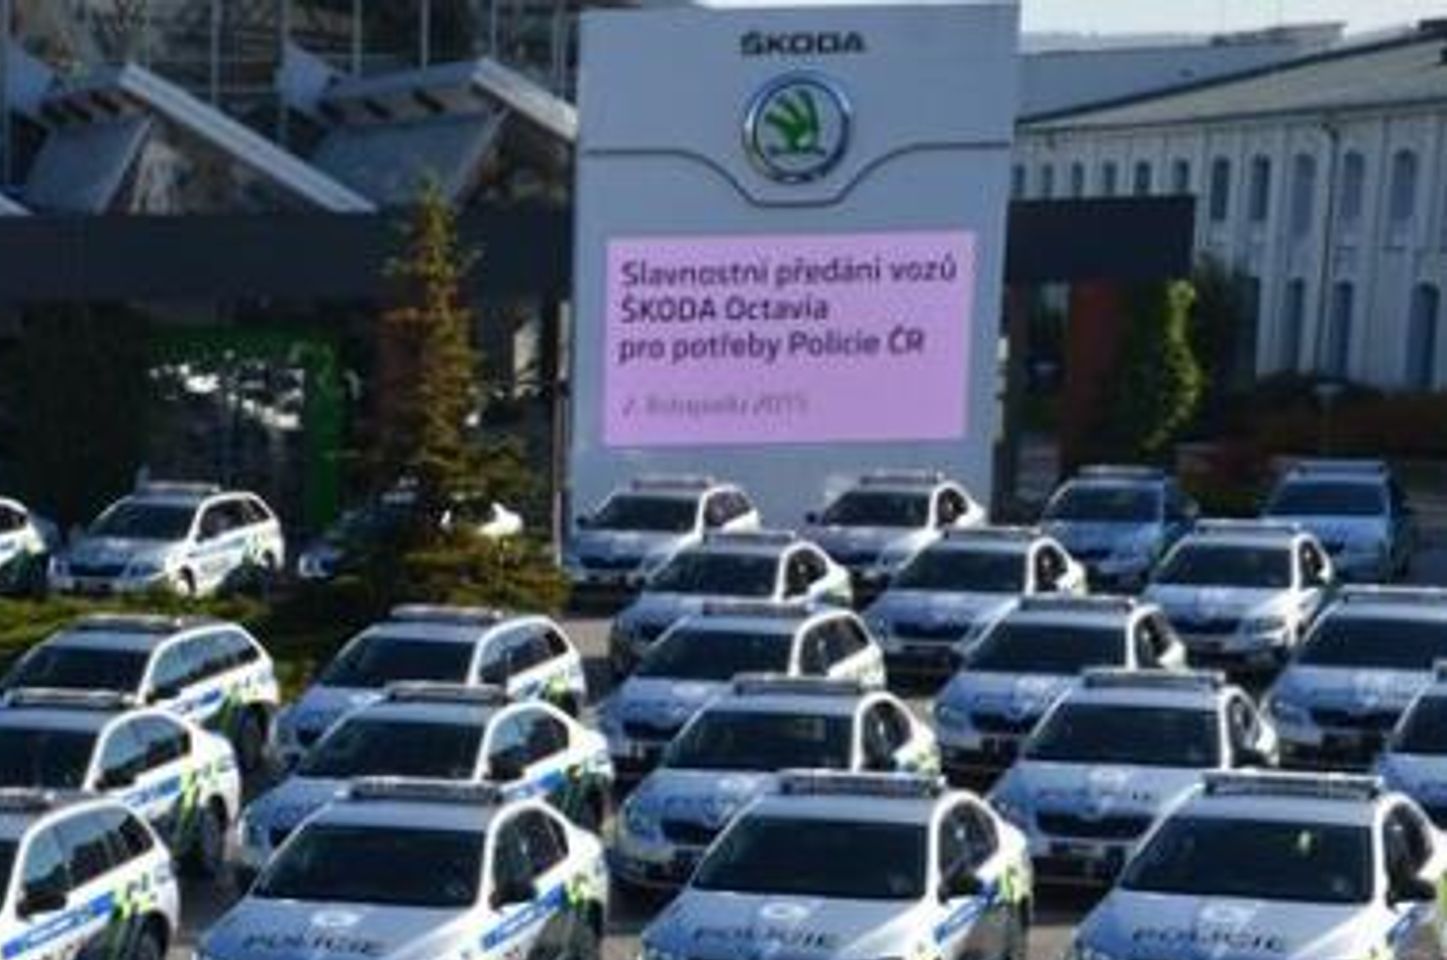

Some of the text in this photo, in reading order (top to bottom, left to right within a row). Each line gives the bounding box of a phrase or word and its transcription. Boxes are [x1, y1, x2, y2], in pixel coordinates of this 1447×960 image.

[621, 252, 957, 290] Slavnostní předání vozů
[621, 293, 829, 323] ŠKODA Octavia
[619, 325, 924, 365] pro potřeby Policie ČR
